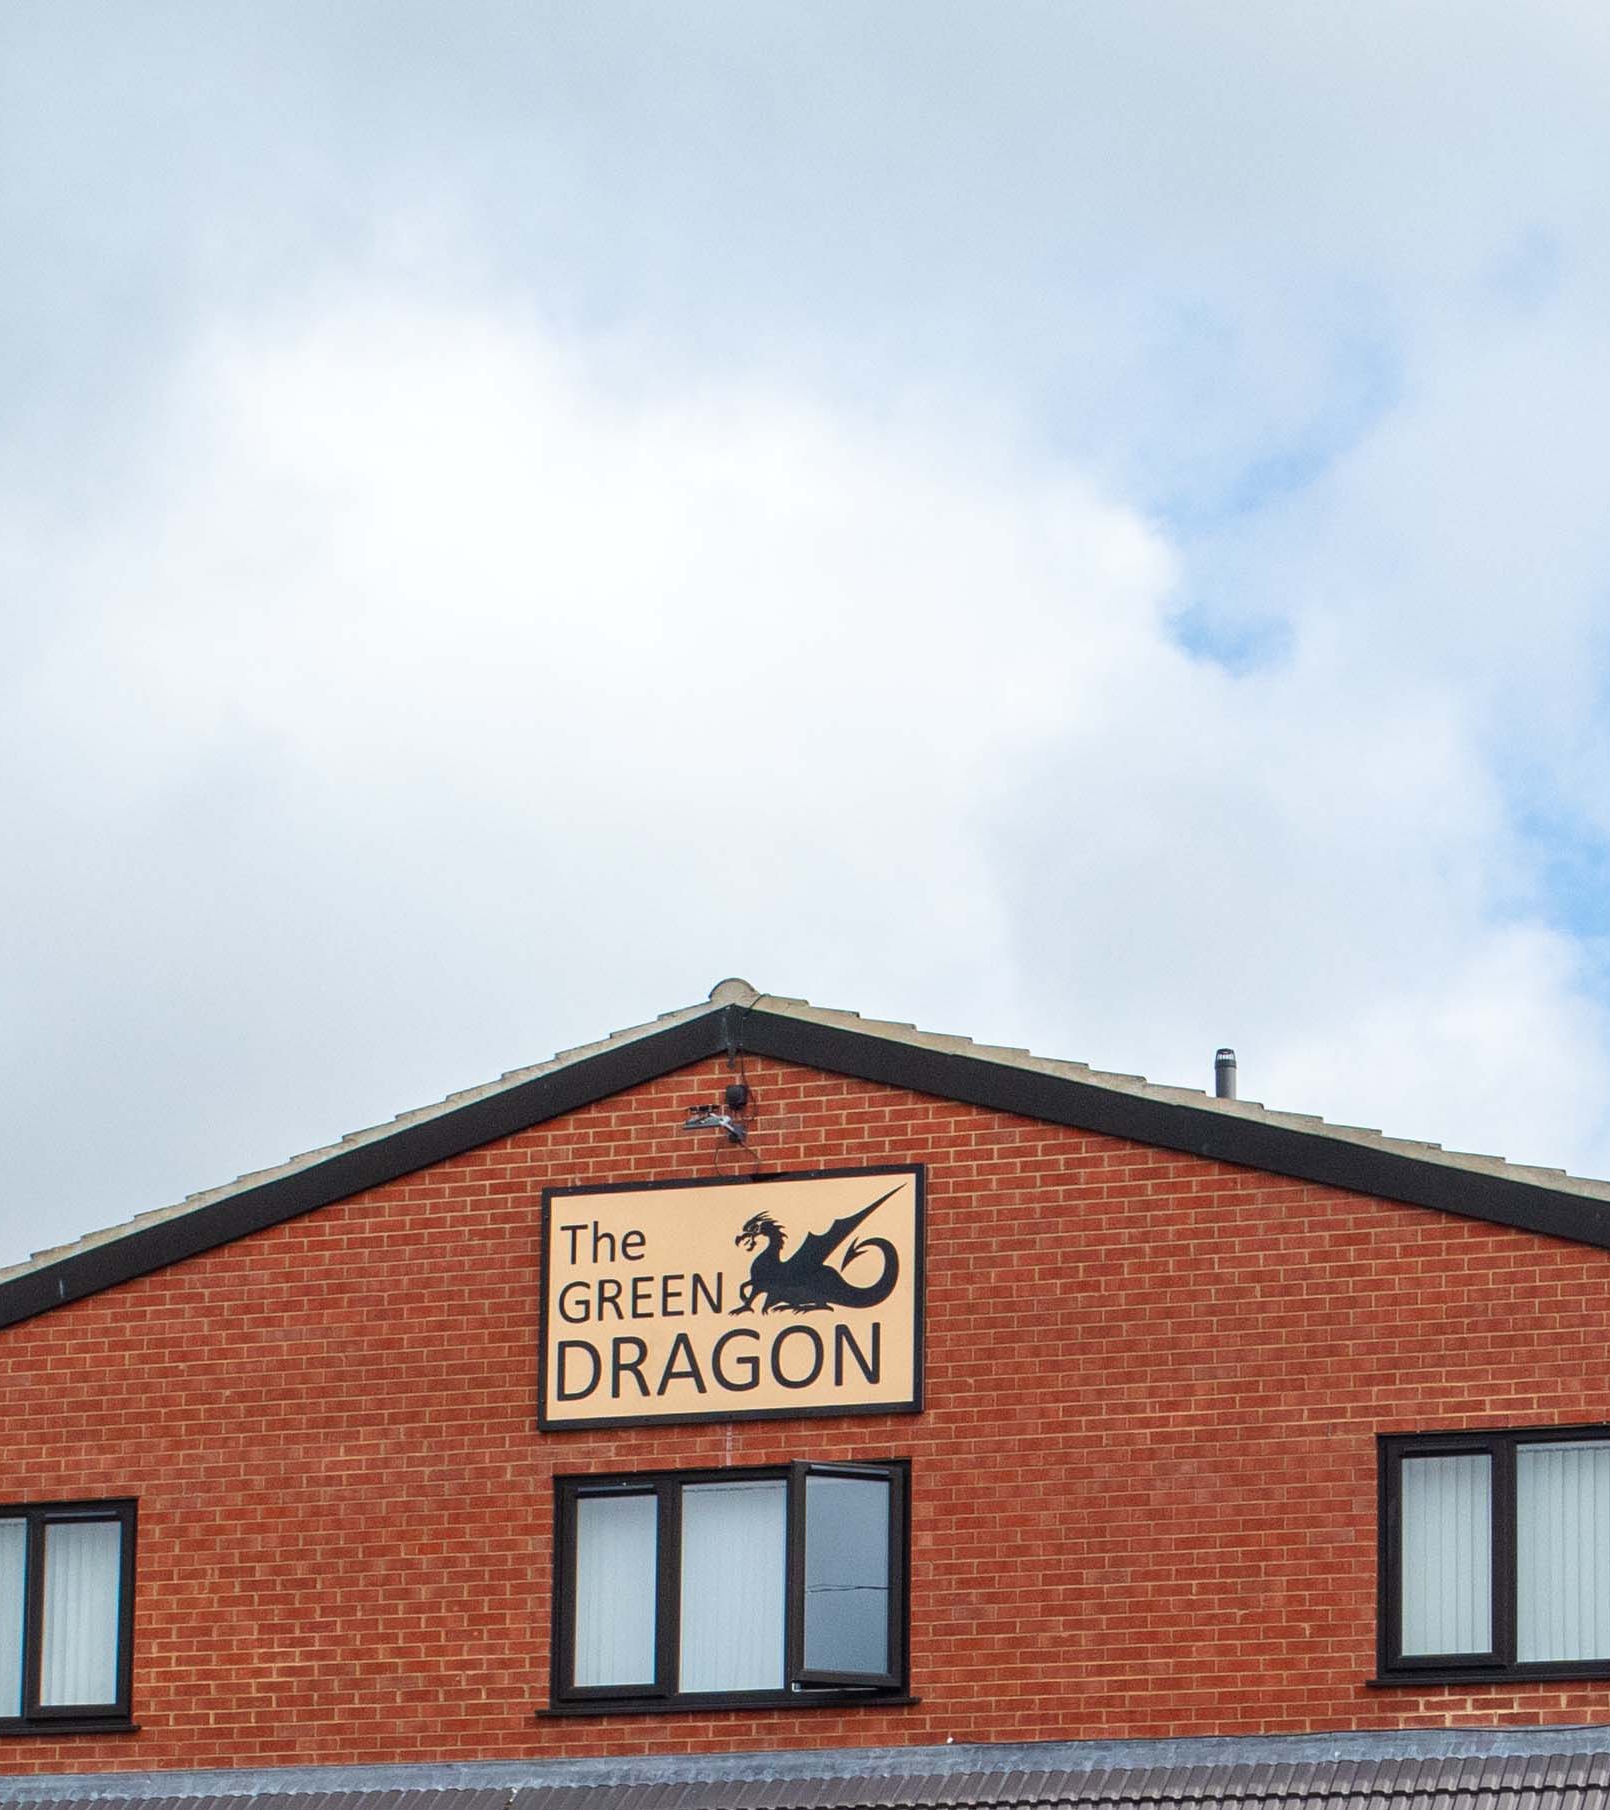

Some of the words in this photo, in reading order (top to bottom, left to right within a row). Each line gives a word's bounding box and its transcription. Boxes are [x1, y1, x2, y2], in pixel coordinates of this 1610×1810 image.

[561, 1221, 646, 1265] The
[559, 1272, 723, 1324] GREEN
[557, 1322, 881, 1401] DRAGON
